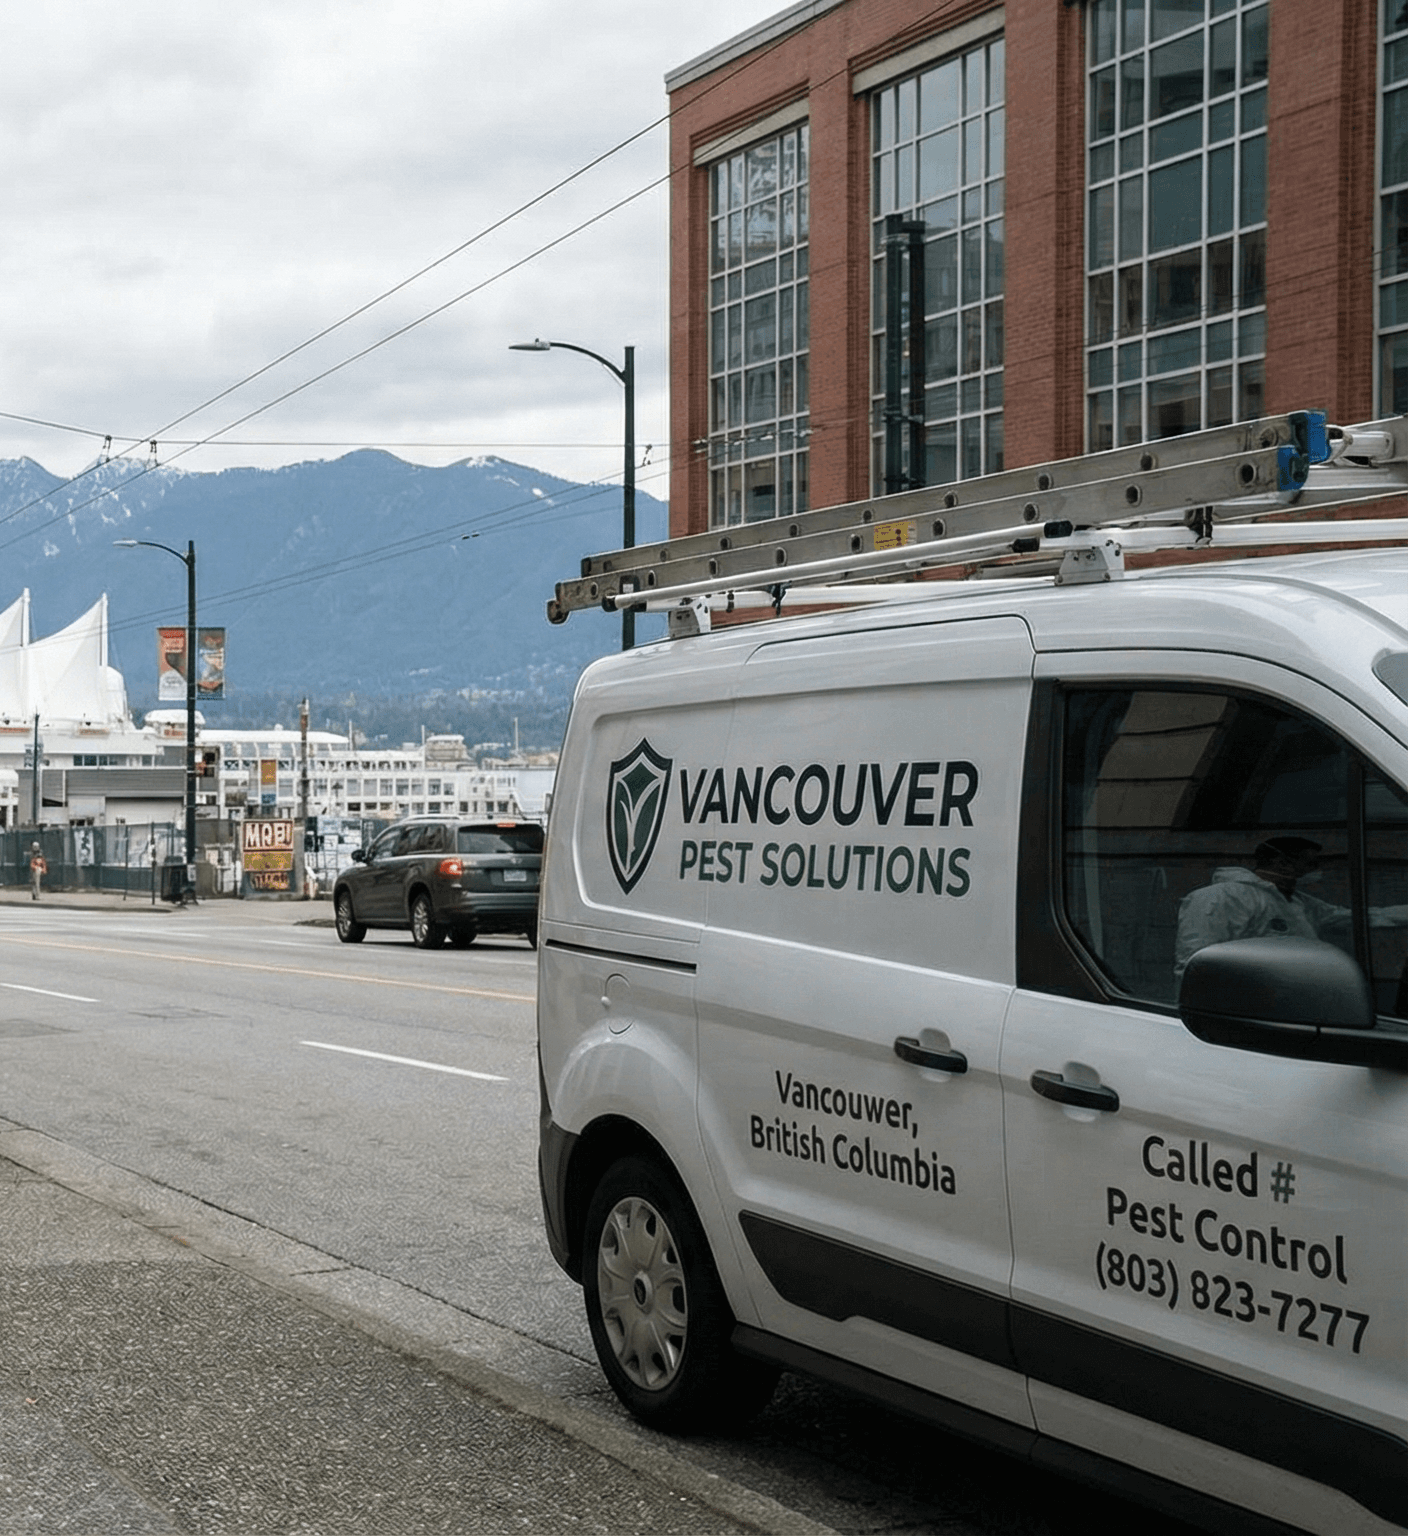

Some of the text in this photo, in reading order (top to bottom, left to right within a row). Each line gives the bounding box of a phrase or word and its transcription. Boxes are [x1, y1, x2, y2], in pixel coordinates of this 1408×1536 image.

[679, 760, 979, 827] VANCOUVER
[679, 839, 972, 898] PEST SOLUTIONS
[750, 1114, 957, 1196] British Columbia
[1142, 1135, 1296, 1205] Called #
[1106, 1186, 1348, 1286] Pest Control
[1095, 1240, 1370, 1355] (803) 823-7277
